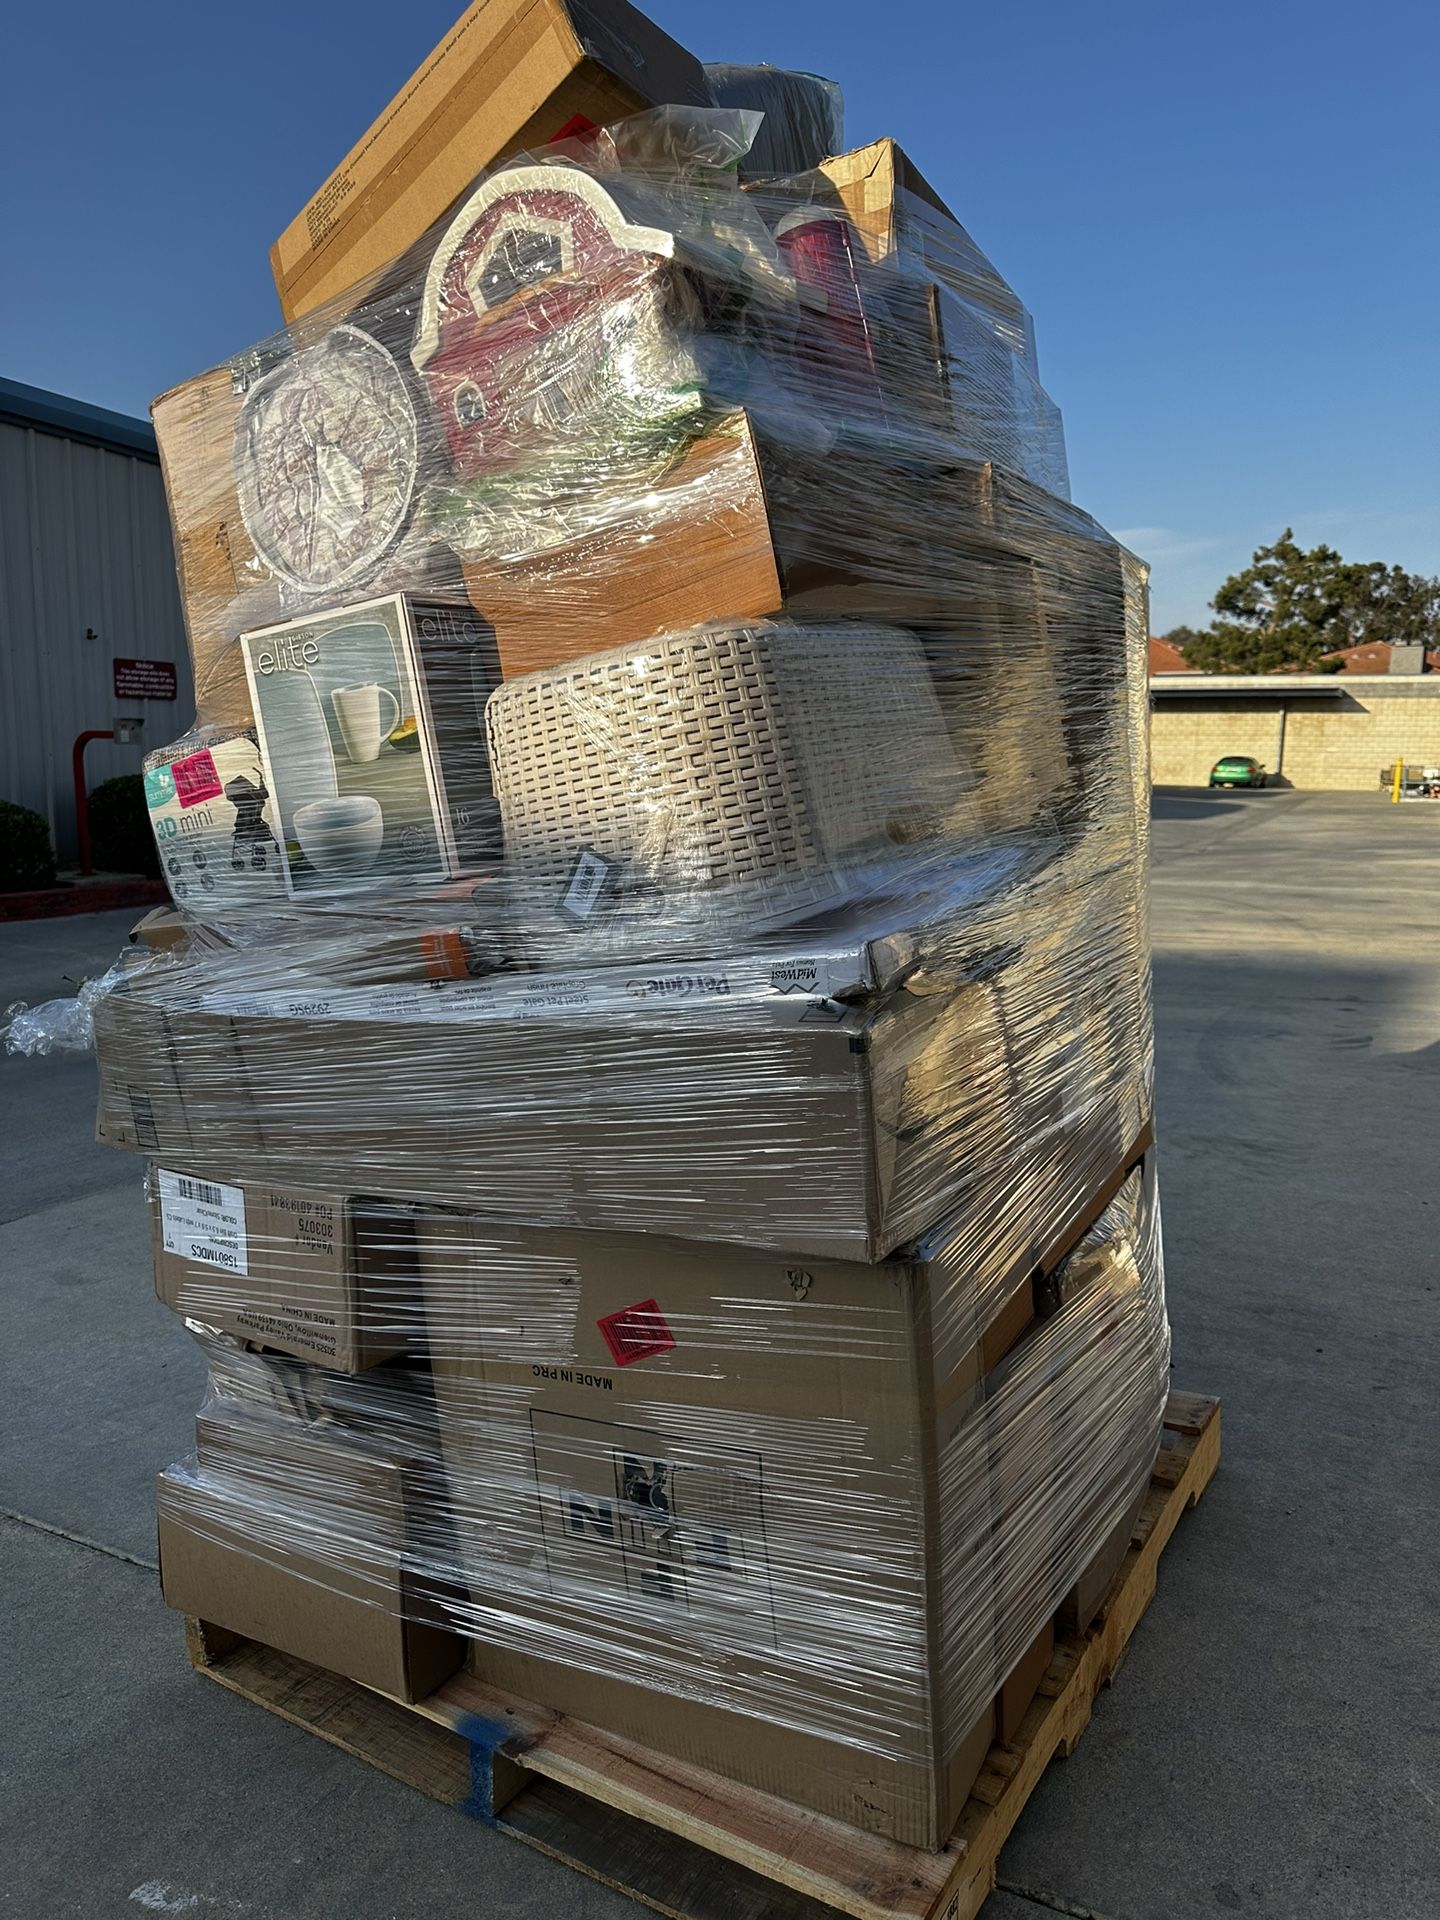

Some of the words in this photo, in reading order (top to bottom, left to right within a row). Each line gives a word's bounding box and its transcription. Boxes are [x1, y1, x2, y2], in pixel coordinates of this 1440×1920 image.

[421, 609, 478, 643] elite
[258, 637, 320, 675] elite
[156, 816, 178, 840] 3D
[179, 804, 214, 834] mini
[771, 968, 817, 981] MidWest
[549, 996, 562, 1006] Pet
[563, 995, 589, 1007] Steel
[299, 1218, 333, 1237] 303075
[303, 1235, 333, 1255] Vendor
[191, 1244, 238, 1268] 15801MDCS
[304, 1311, 313, 1319] IN
[313, 1313, 336, 1326] MADE
[237, 1315, 264, 1332] Parkway
[278, 1320, 294, 1332] Ohio
[287, 1335, 316, 1349] Emerald
[316, 1344, 337, 1356] 30325
[532, 1364, 558, 1379] PRC
[561, 1369, 573, 1382] IN
[576, 1372, 613, 1390] MADE
